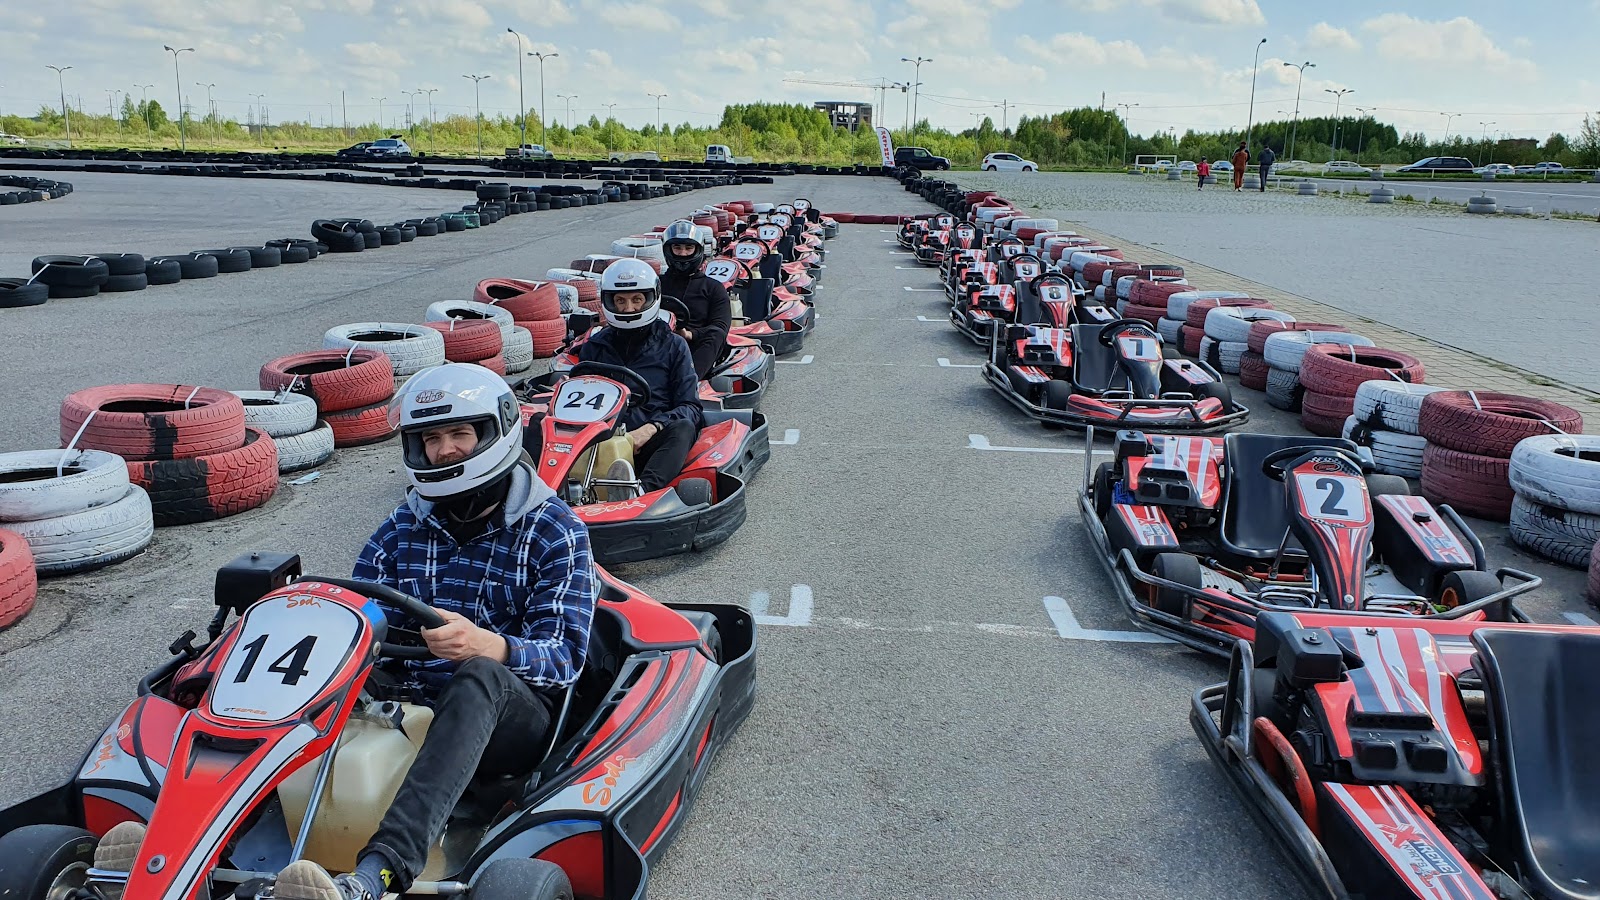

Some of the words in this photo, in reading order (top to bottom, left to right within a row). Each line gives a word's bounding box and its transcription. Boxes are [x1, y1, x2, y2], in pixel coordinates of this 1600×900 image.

[739, 247, 756, 255] 23
[1008, 246, 1018, 255] 6
[709, 266, 730, 277] 22
[1022, 264, 1033, 275] 9
[1048, 286, 1062, 299] 8
[563, 391, 605, 410] 24
[1315, 477, 1349, 516] 2
[286, 592, 321, 608] Sodi
[233, 634, 318, 686] 14
